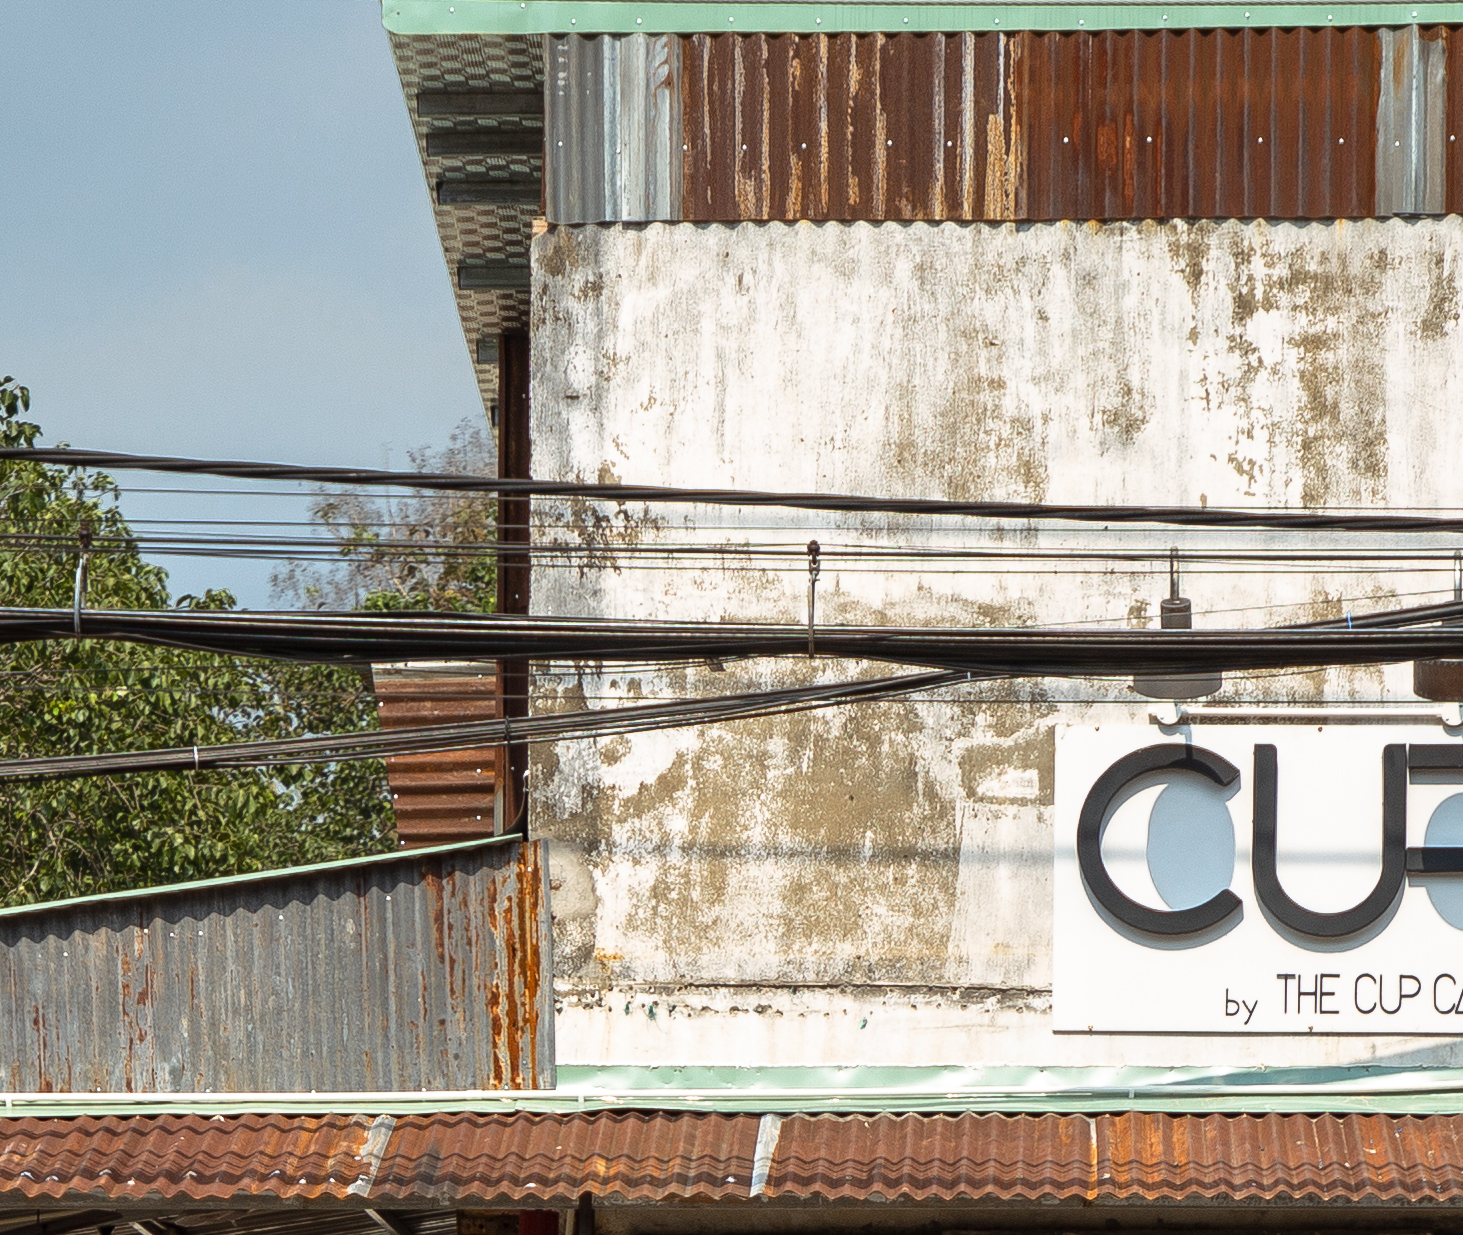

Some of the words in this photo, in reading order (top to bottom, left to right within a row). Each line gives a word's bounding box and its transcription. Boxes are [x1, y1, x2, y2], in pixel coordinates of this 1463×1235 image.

[1224, 987, 1259, 1026] by
[1276, 972, 1341, 1015] THE
[1354, 972, 1422, 1015] CUP
